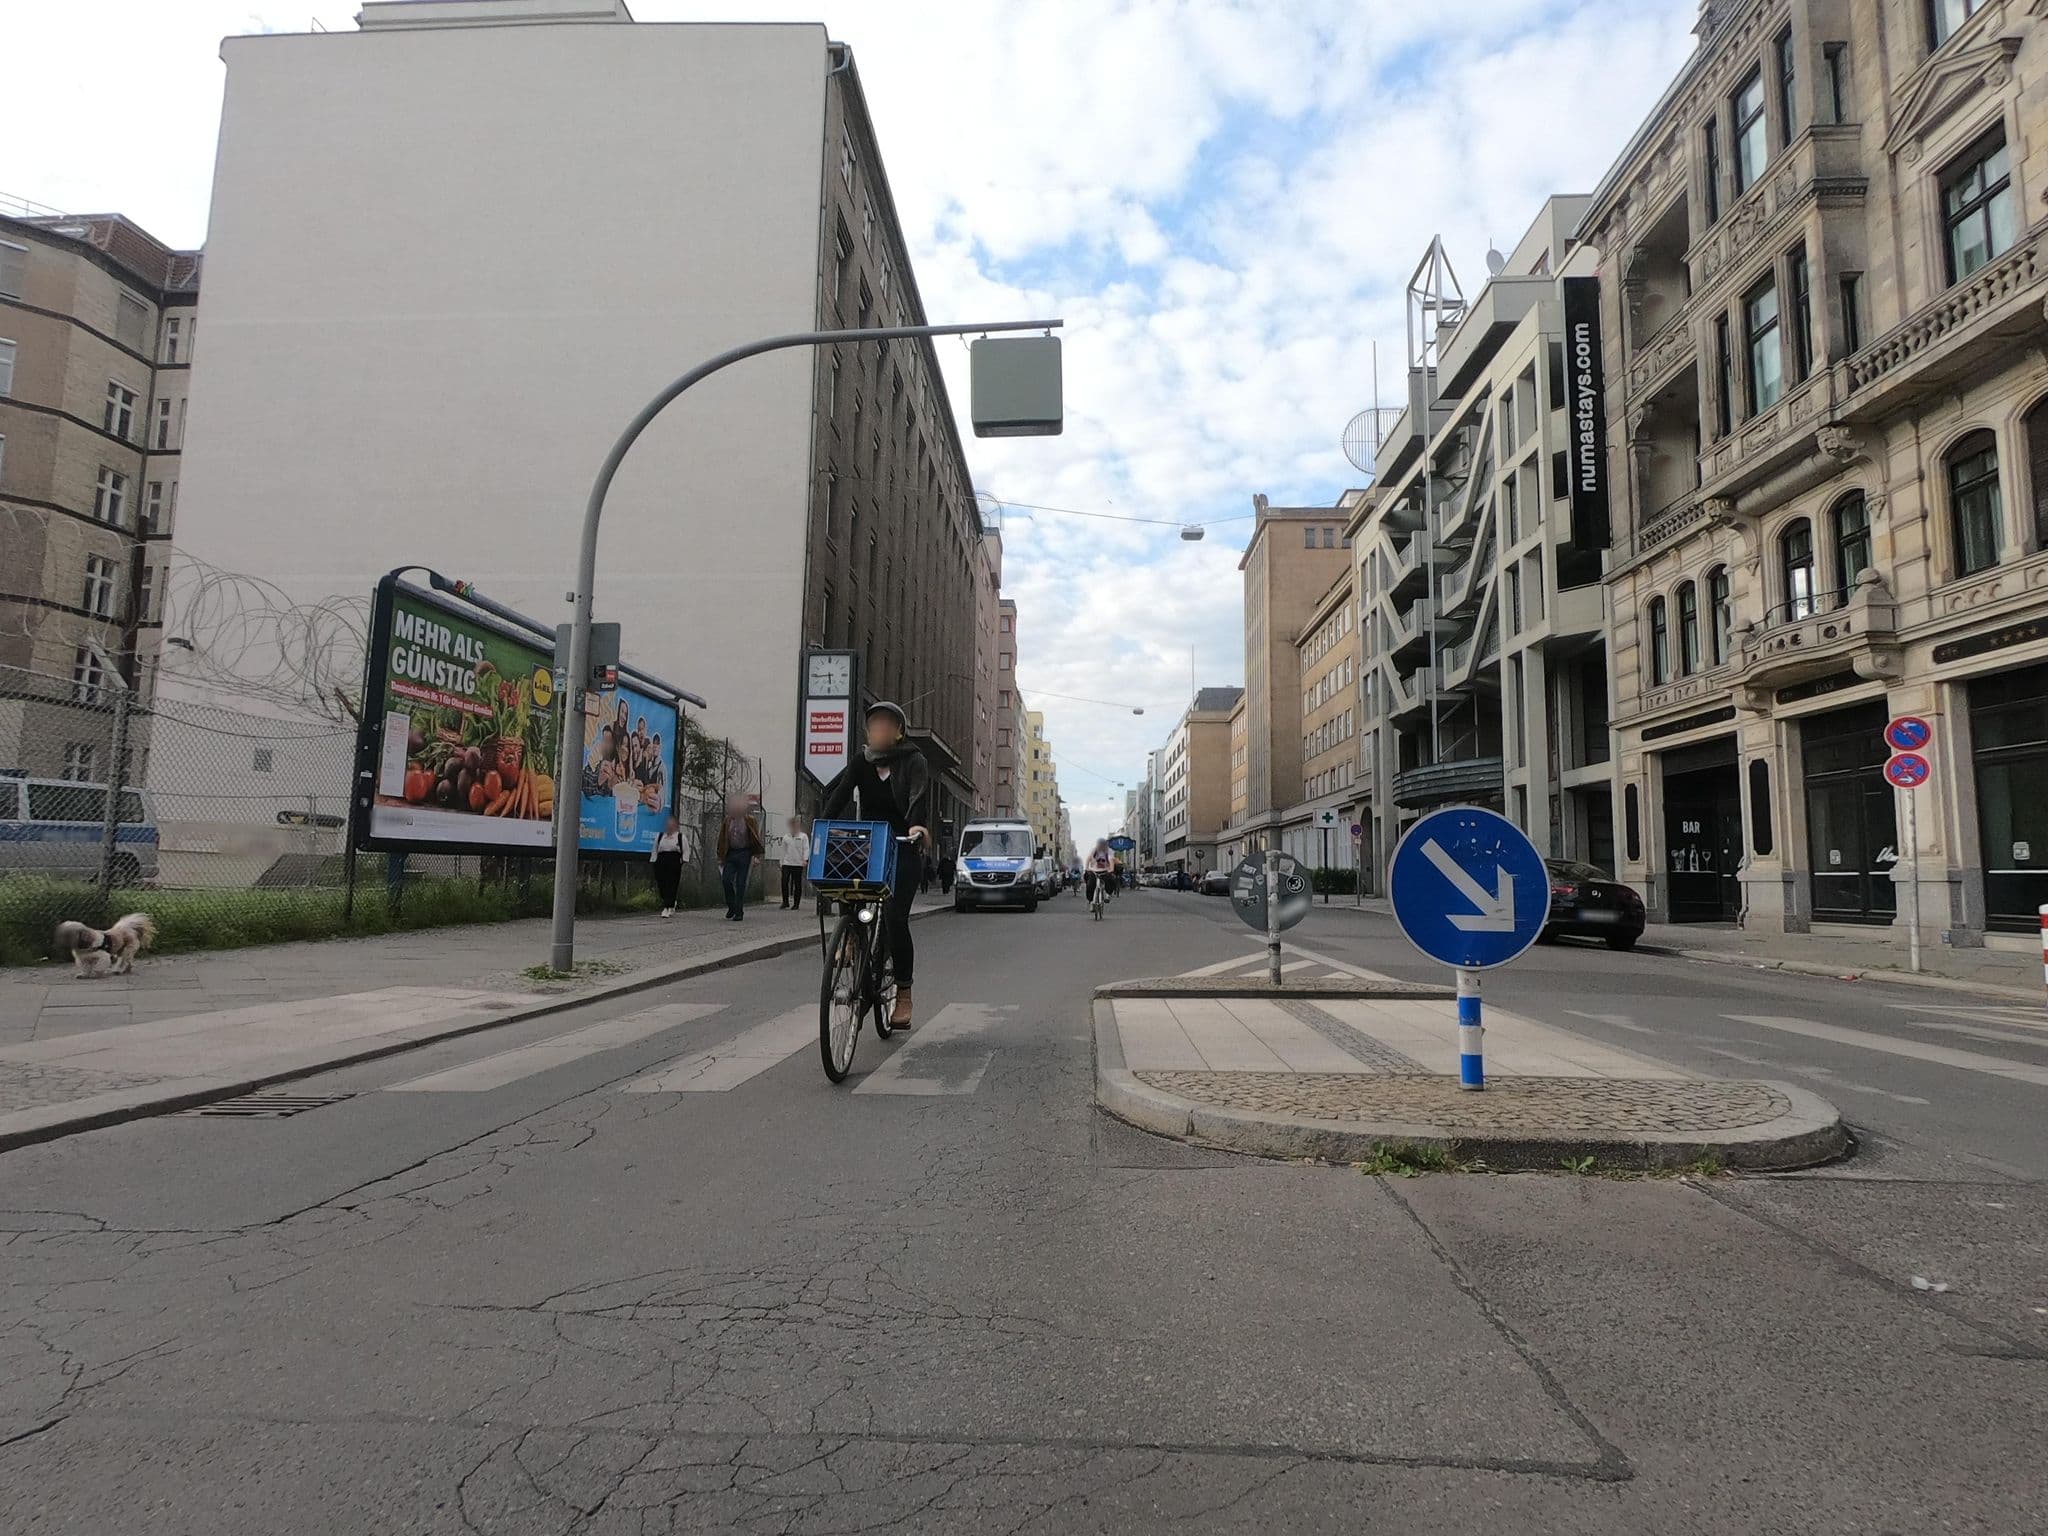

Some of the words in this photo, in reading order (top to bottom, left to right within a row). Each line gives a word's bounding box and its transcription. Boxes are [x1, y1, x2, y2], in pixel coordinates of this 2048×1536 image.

[1575, 323, 1597, 492] numastays.com
[395, 609, 450, 651] MEHR
[453, 629, 484, 663] ALS
[391, 646, 476, 695] GÜNSTIG
[1683, 821, 1701, 834] BAR
